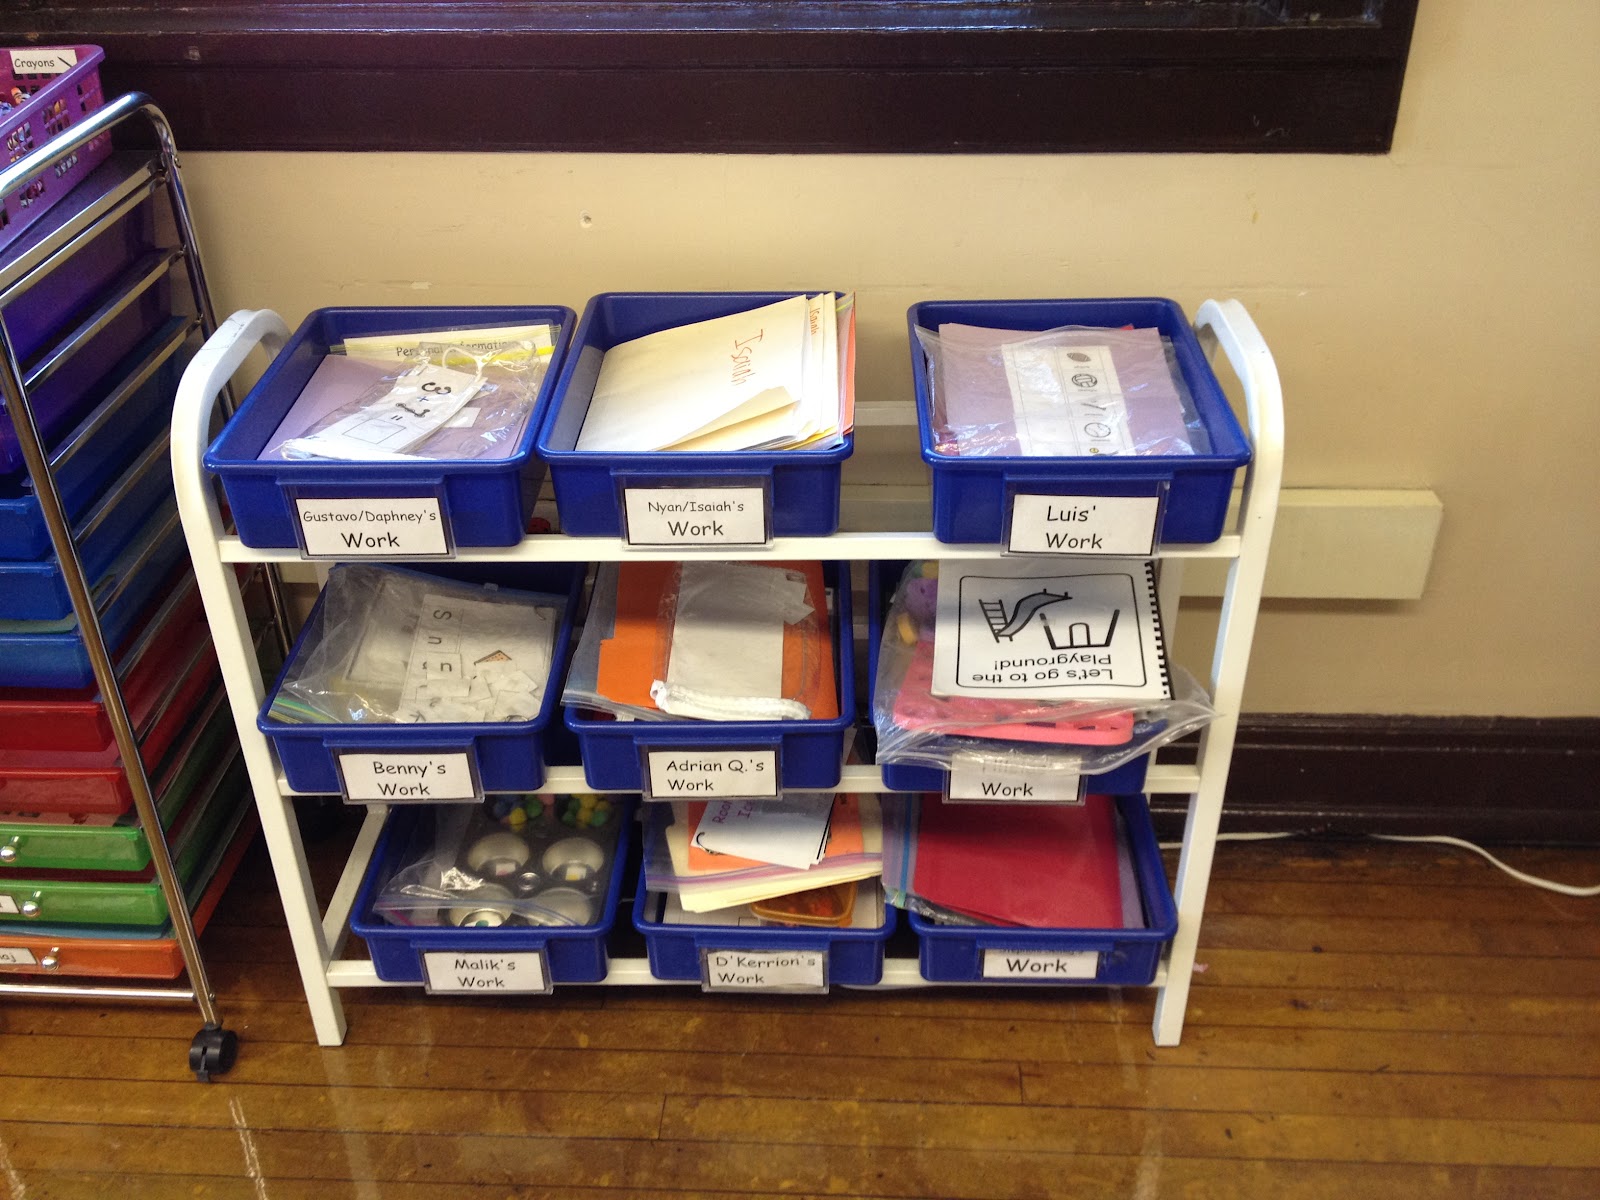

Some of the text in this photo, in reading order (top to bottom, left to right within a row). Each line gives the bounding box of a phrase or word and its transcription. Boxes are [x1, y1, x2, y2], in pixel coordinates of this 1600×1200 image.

[14, 58, 55, 70] Crayons
[648, 501, 744, 515] Nyan/Isaiah's
[1046, 505, 1096, 522] Luis'
[303, 510, 437, 524] Gustavo/Daphney's
[667, 520, 724, 536] Work
[341, 532, 400, 548] Work
[1045, 532, 1103, 549] Work
[994, 652, 1112, 670] Playground!
[972, 668, 1113, 683] Let's go to the
[373, 761, 446, 778] Benny's
[666, 759, 764, 774] Adrian Q.'s
[377, 782, 430, 796] Work
[667, 779, 714, 791] Work
[981, 782, 1034, 797] Work
[454, 959, 516, 971] Malik's
[716, 956, 816, 968] D'Kerrion's
[1006, 958, 1067, 973] Work
[457, 976, 505, 988] Work
[717, 973, 765, 984] Work
